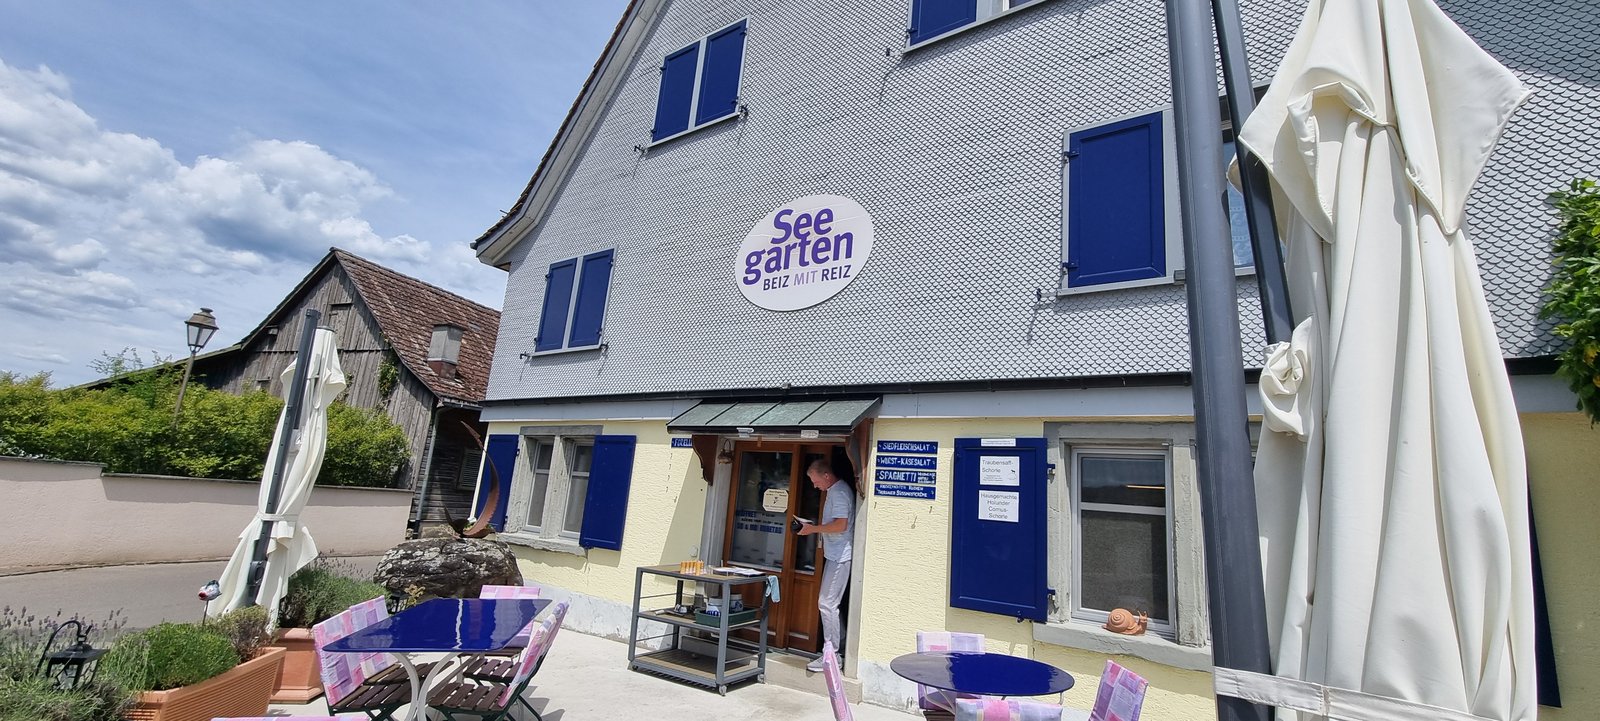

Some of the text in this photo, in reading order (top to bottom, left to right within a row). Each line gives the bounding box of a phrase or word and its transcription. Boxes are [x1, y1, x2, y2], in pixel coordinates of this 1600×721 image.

[770, 208, 834, 245] See
[742, 231, 854, 286] garten
[763, 264, 852, 291] BEIZ MIT REIZ
[882, 442, 930, 451] SIEDFLEISCHSALAT
[879, 470, 917, 482] SPAGHETTI
